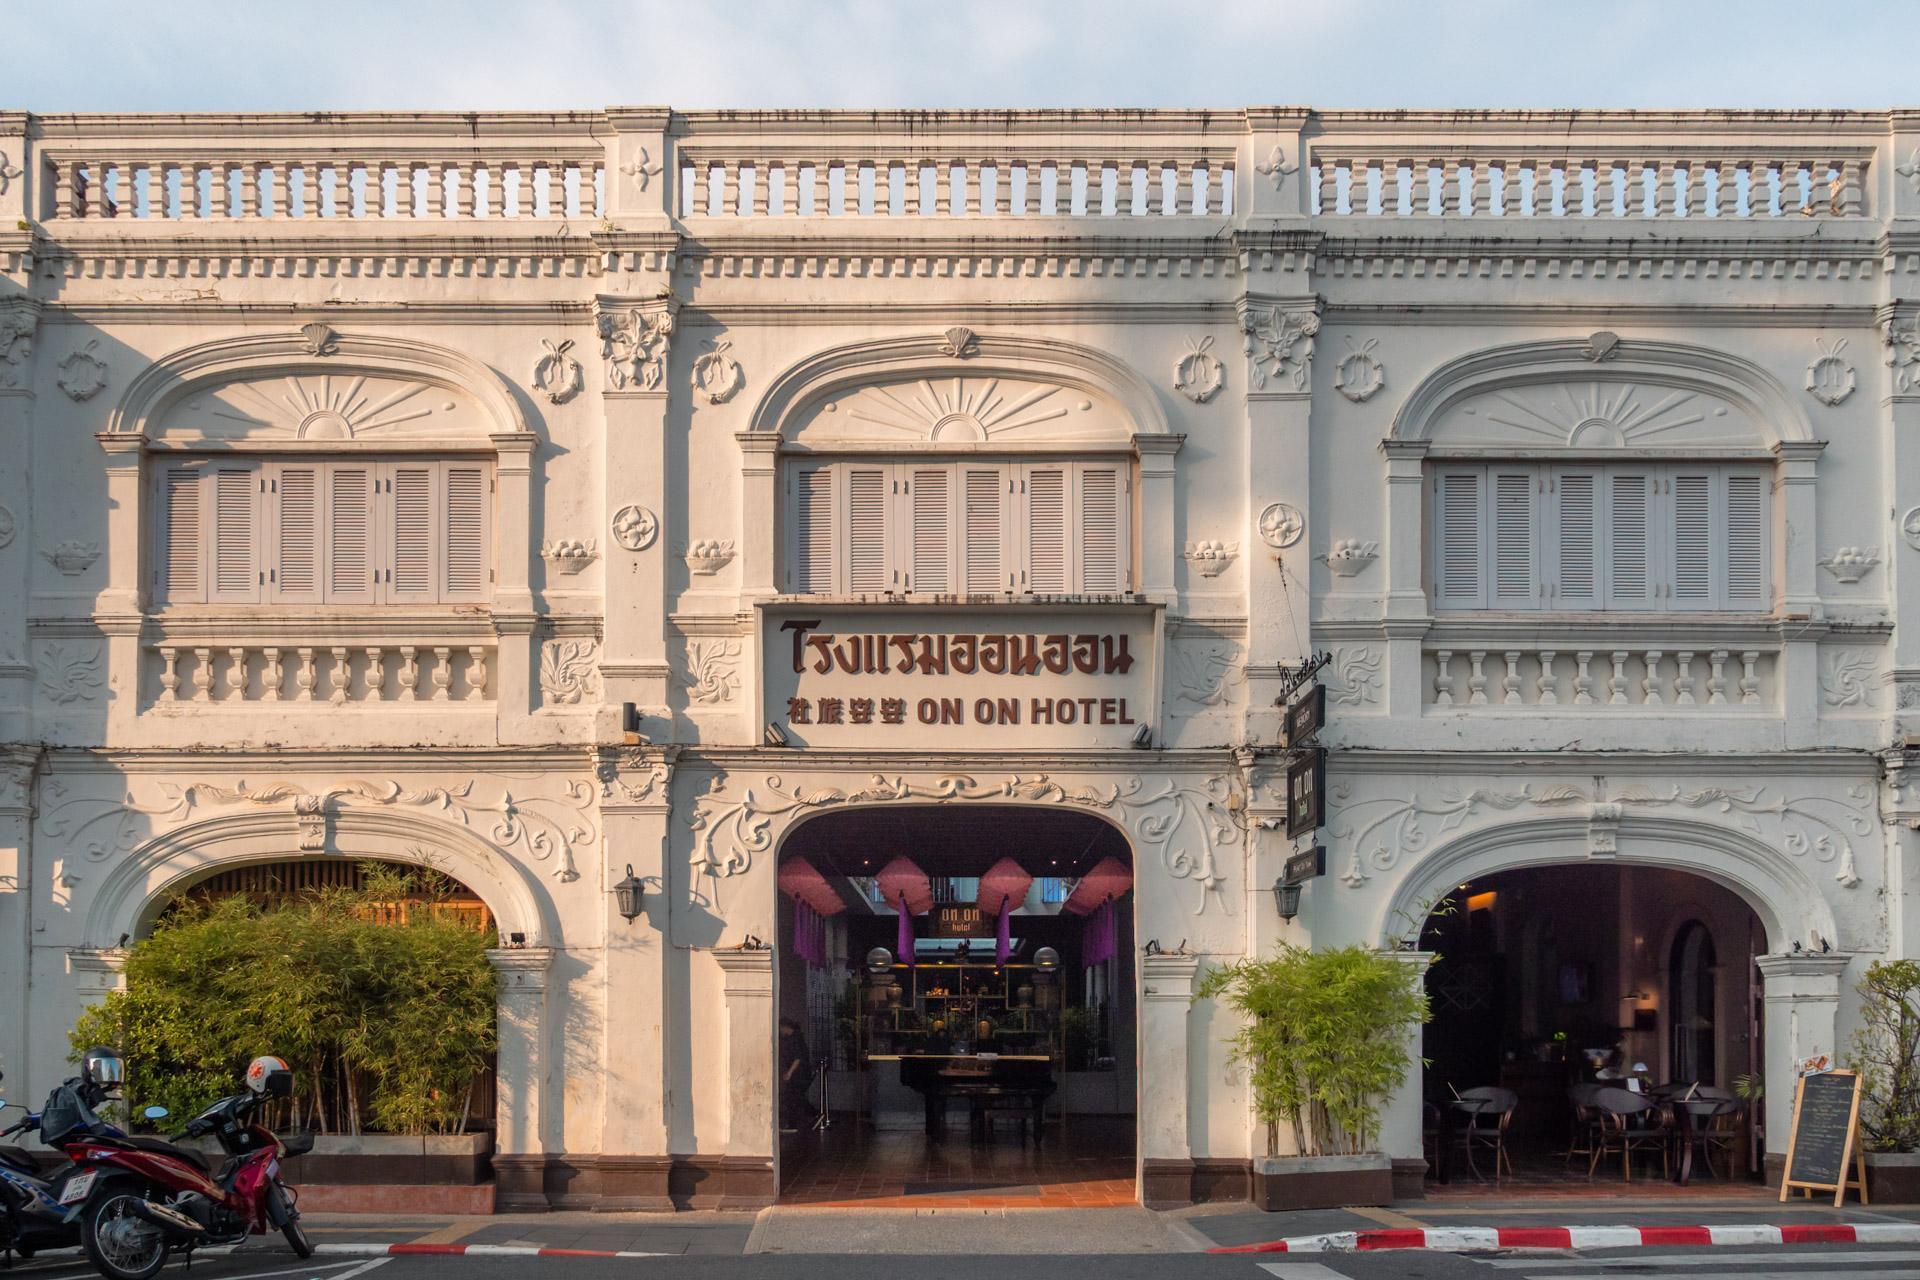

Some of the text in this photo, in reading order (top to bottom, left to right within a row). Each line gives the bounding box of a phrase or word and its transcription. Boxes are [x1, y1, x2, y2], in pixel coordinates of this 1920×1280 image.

[780, 620, 1134, 674] โรงแรมออนออน
[917, 698, 1134, 724] ON ON HOTEL
